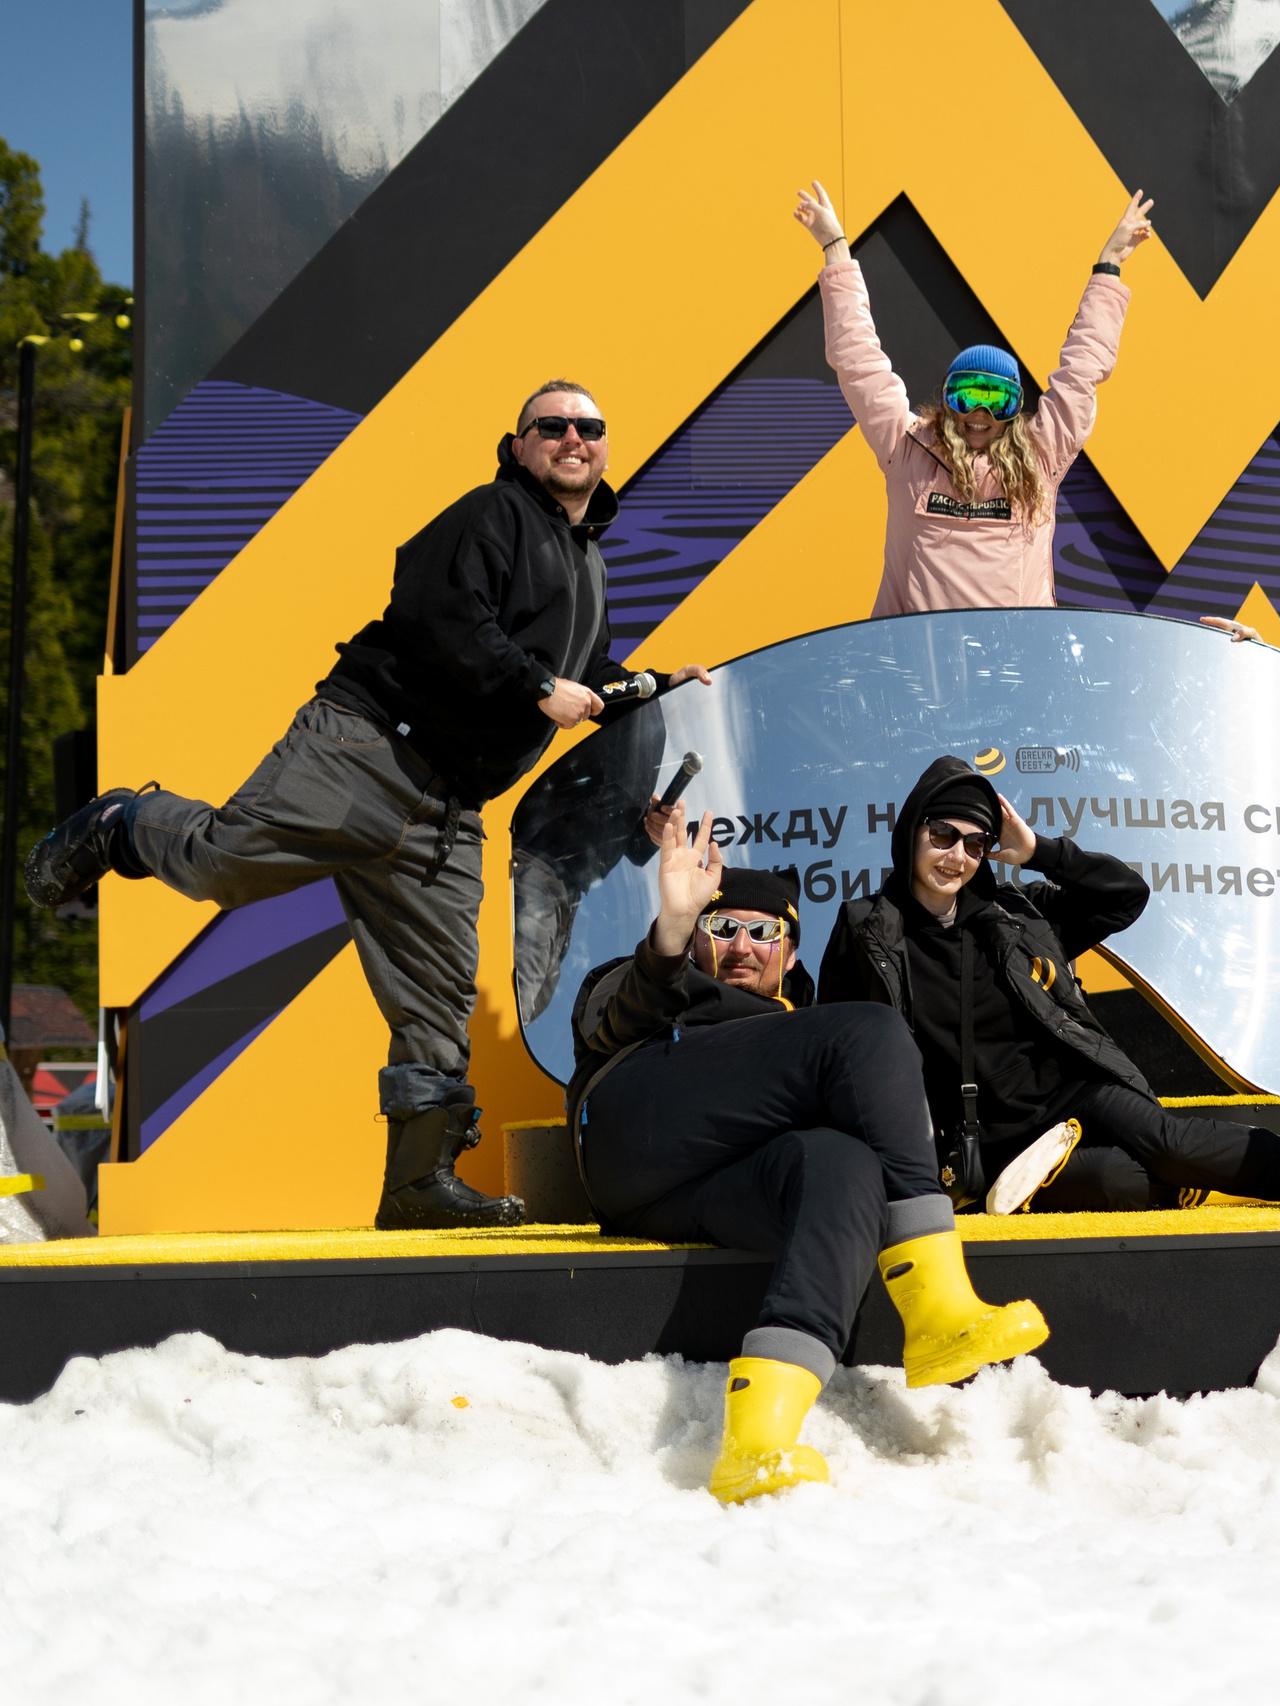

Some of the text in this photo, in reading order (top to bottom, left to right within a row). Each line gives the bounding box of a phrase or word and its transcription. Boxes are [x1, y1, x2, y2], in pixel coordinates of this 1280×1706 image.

[1022, 751, 1052, 760] GRELKA
[1022, 761, 1043, 770] FEST
[1026, 797, 1226, 838] лучшая
